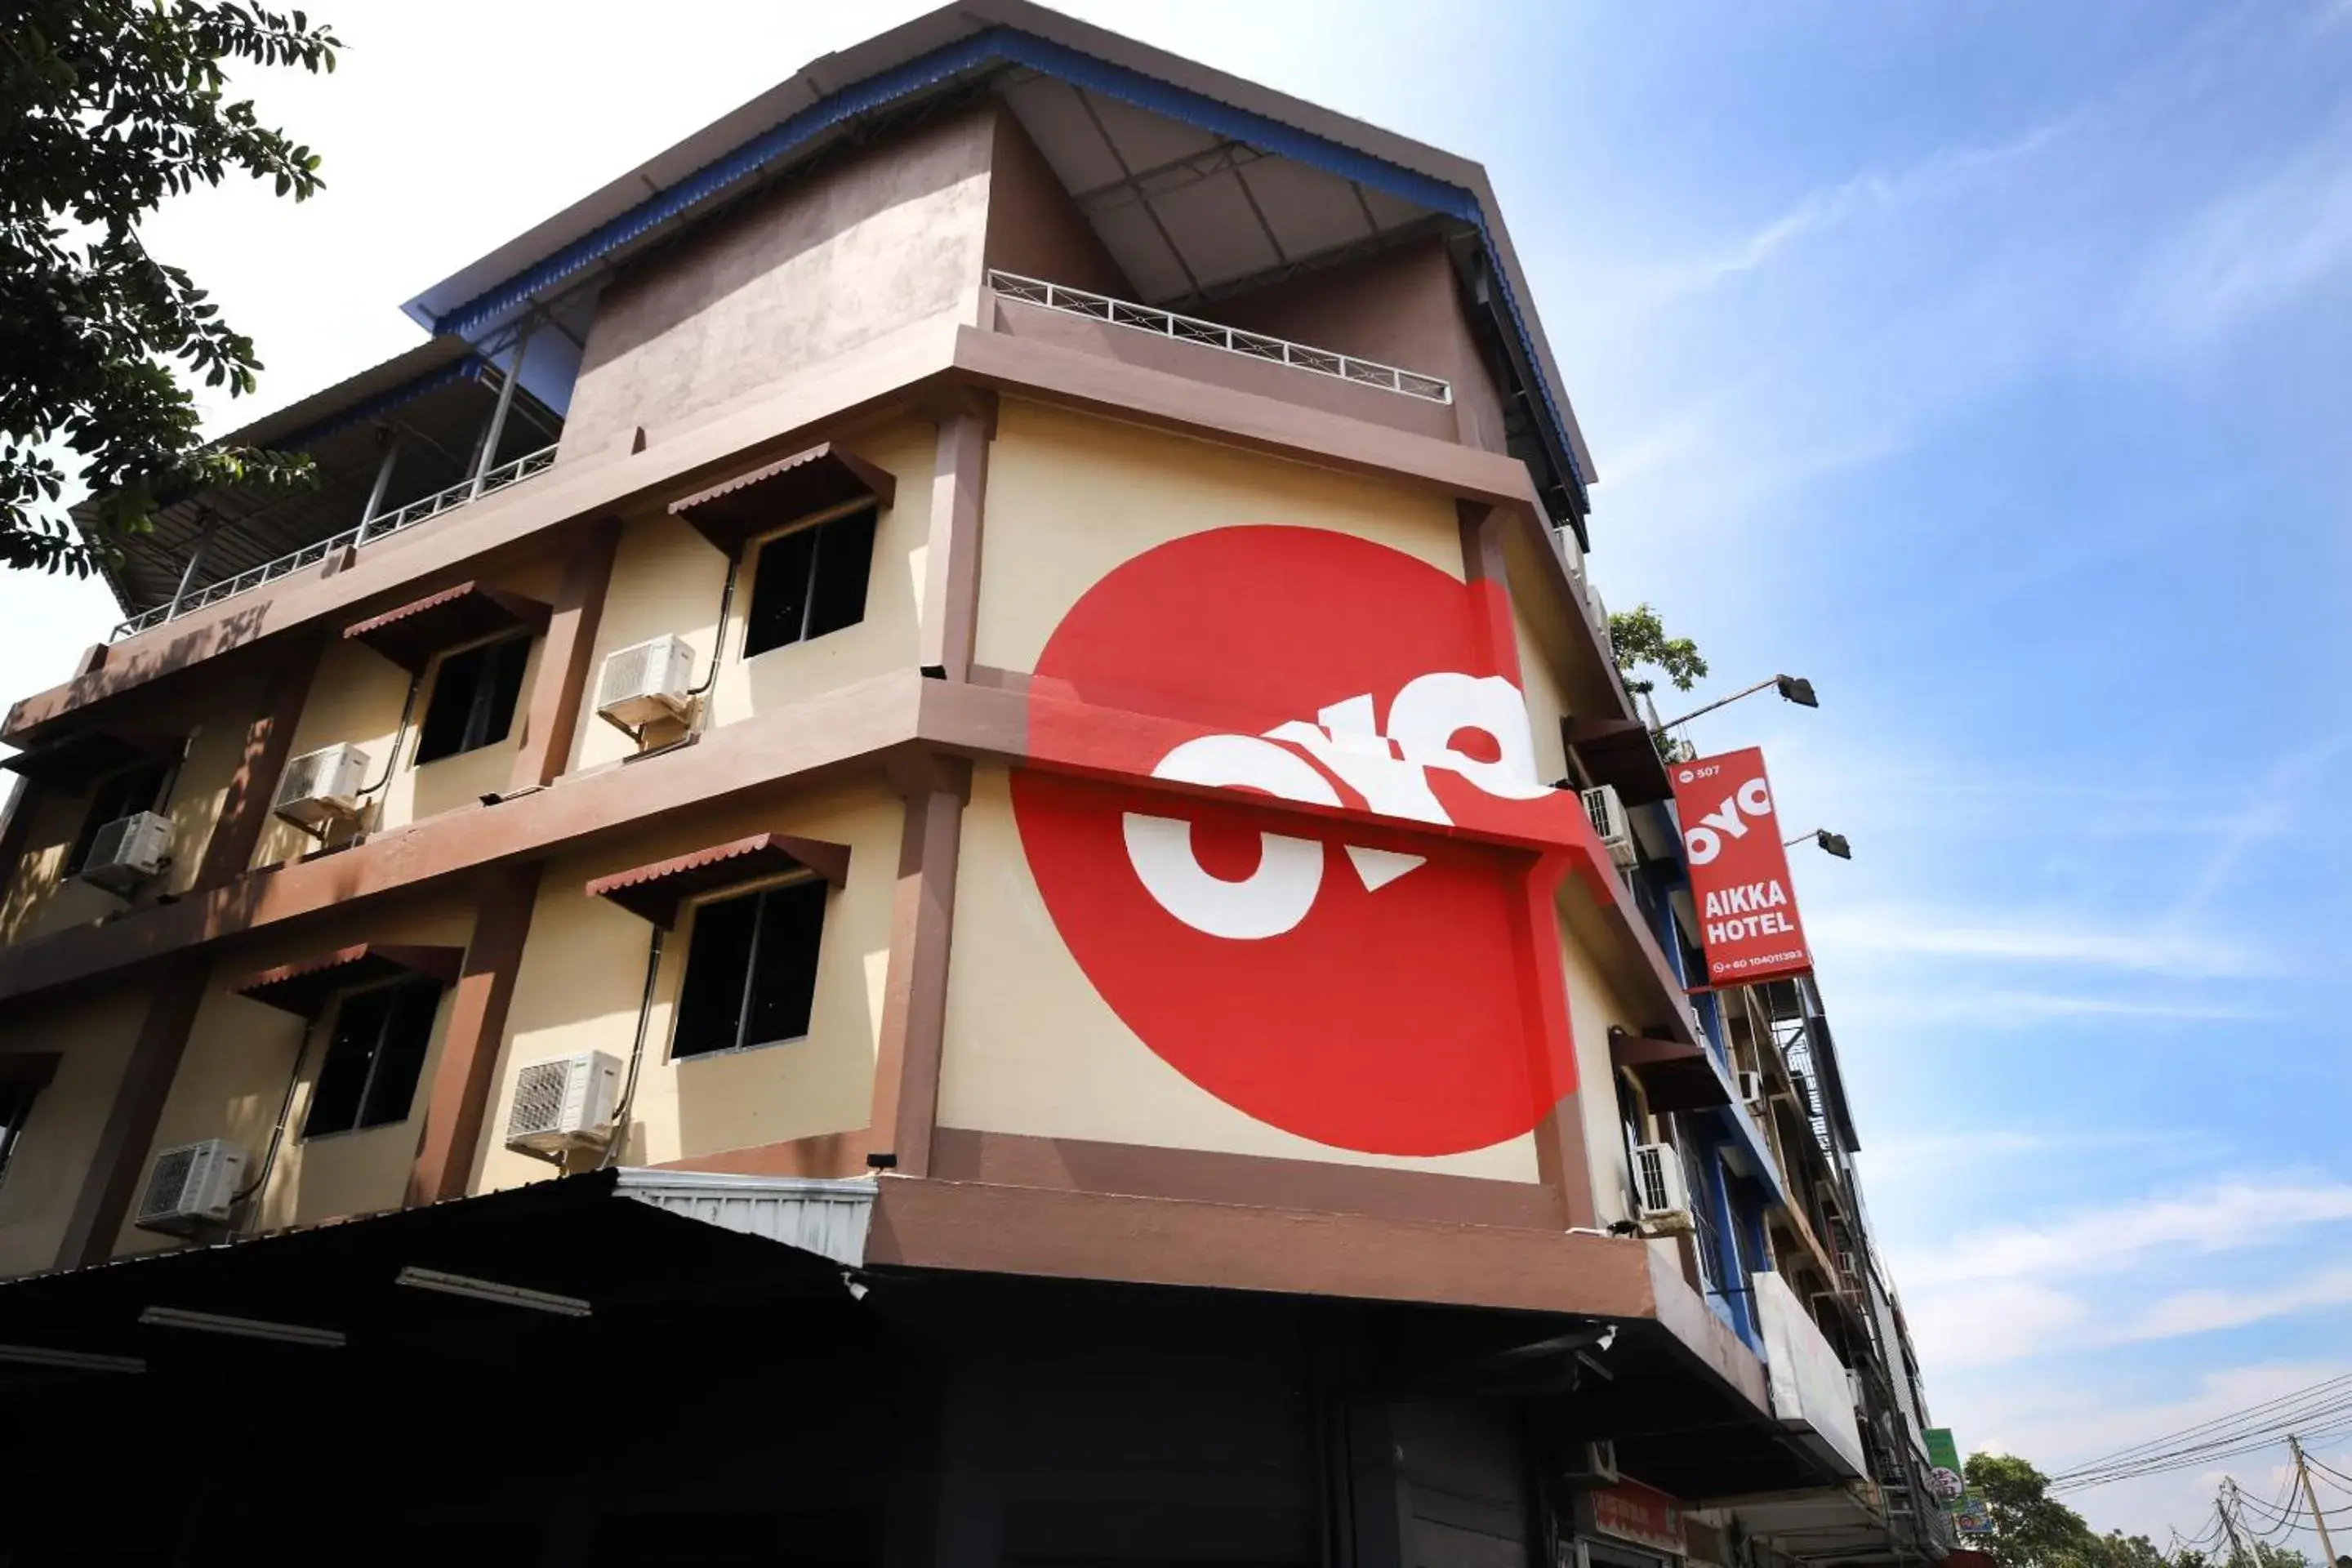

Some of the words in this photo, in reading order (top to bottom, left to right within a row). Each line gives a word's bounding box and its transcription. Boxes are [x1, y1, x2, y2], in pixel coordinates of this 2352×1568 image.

[1685, 777, 1772, 865] OYO
[1705, 880, 1787, 918] AIKKA
[1707, 911, 1794, 944] HOTEL
